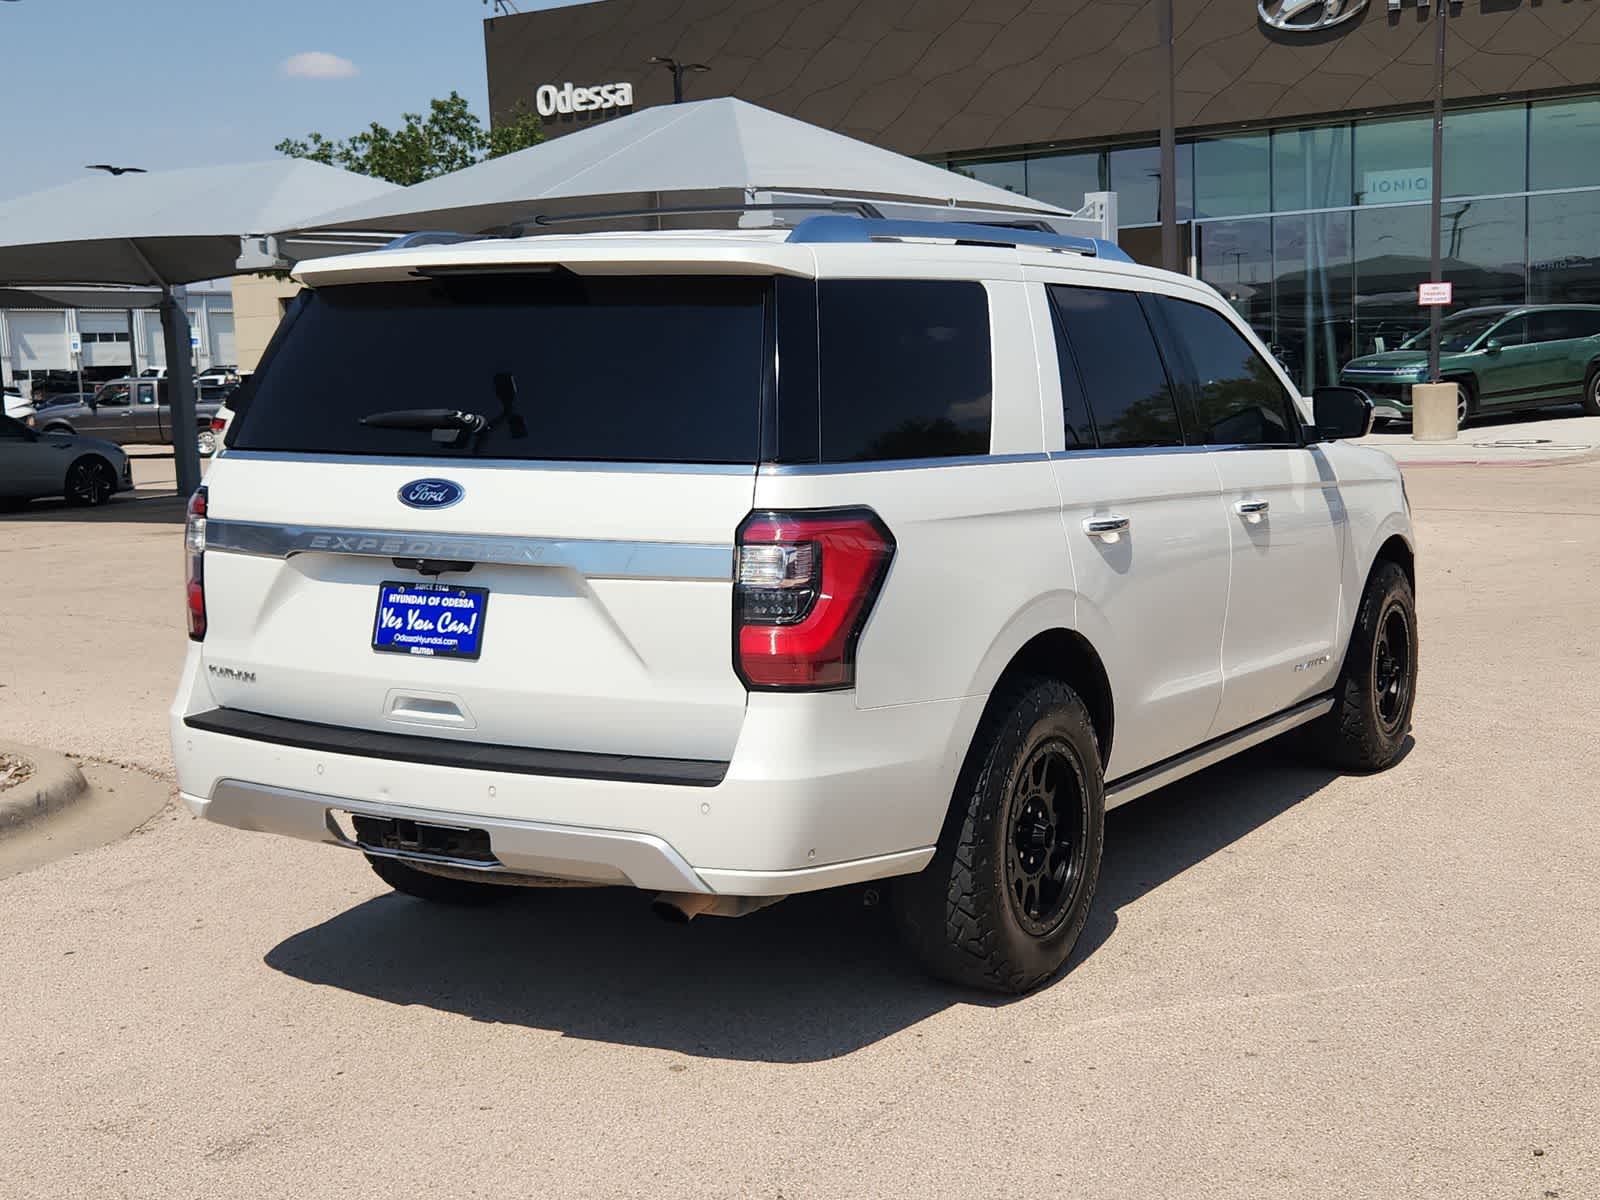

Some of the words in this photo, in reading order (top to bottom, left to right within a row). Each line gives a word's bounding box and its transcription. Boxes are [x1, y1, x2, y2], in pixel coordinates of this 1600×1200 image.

[536, 82, 633, 116] Odessa
[409, 483, 449, 503] Ford
[310, 535, 545, 561] EXPEDITION
[389, 593, 427, 606] HYUNDAI
[427, 596, 441, 606] OF
[441, 597, 475, 609] ODESSA
[381, 607, 403, 630] Yes
[407, 608, 434, 631] You
[437, 611, 478, 635] Can!
